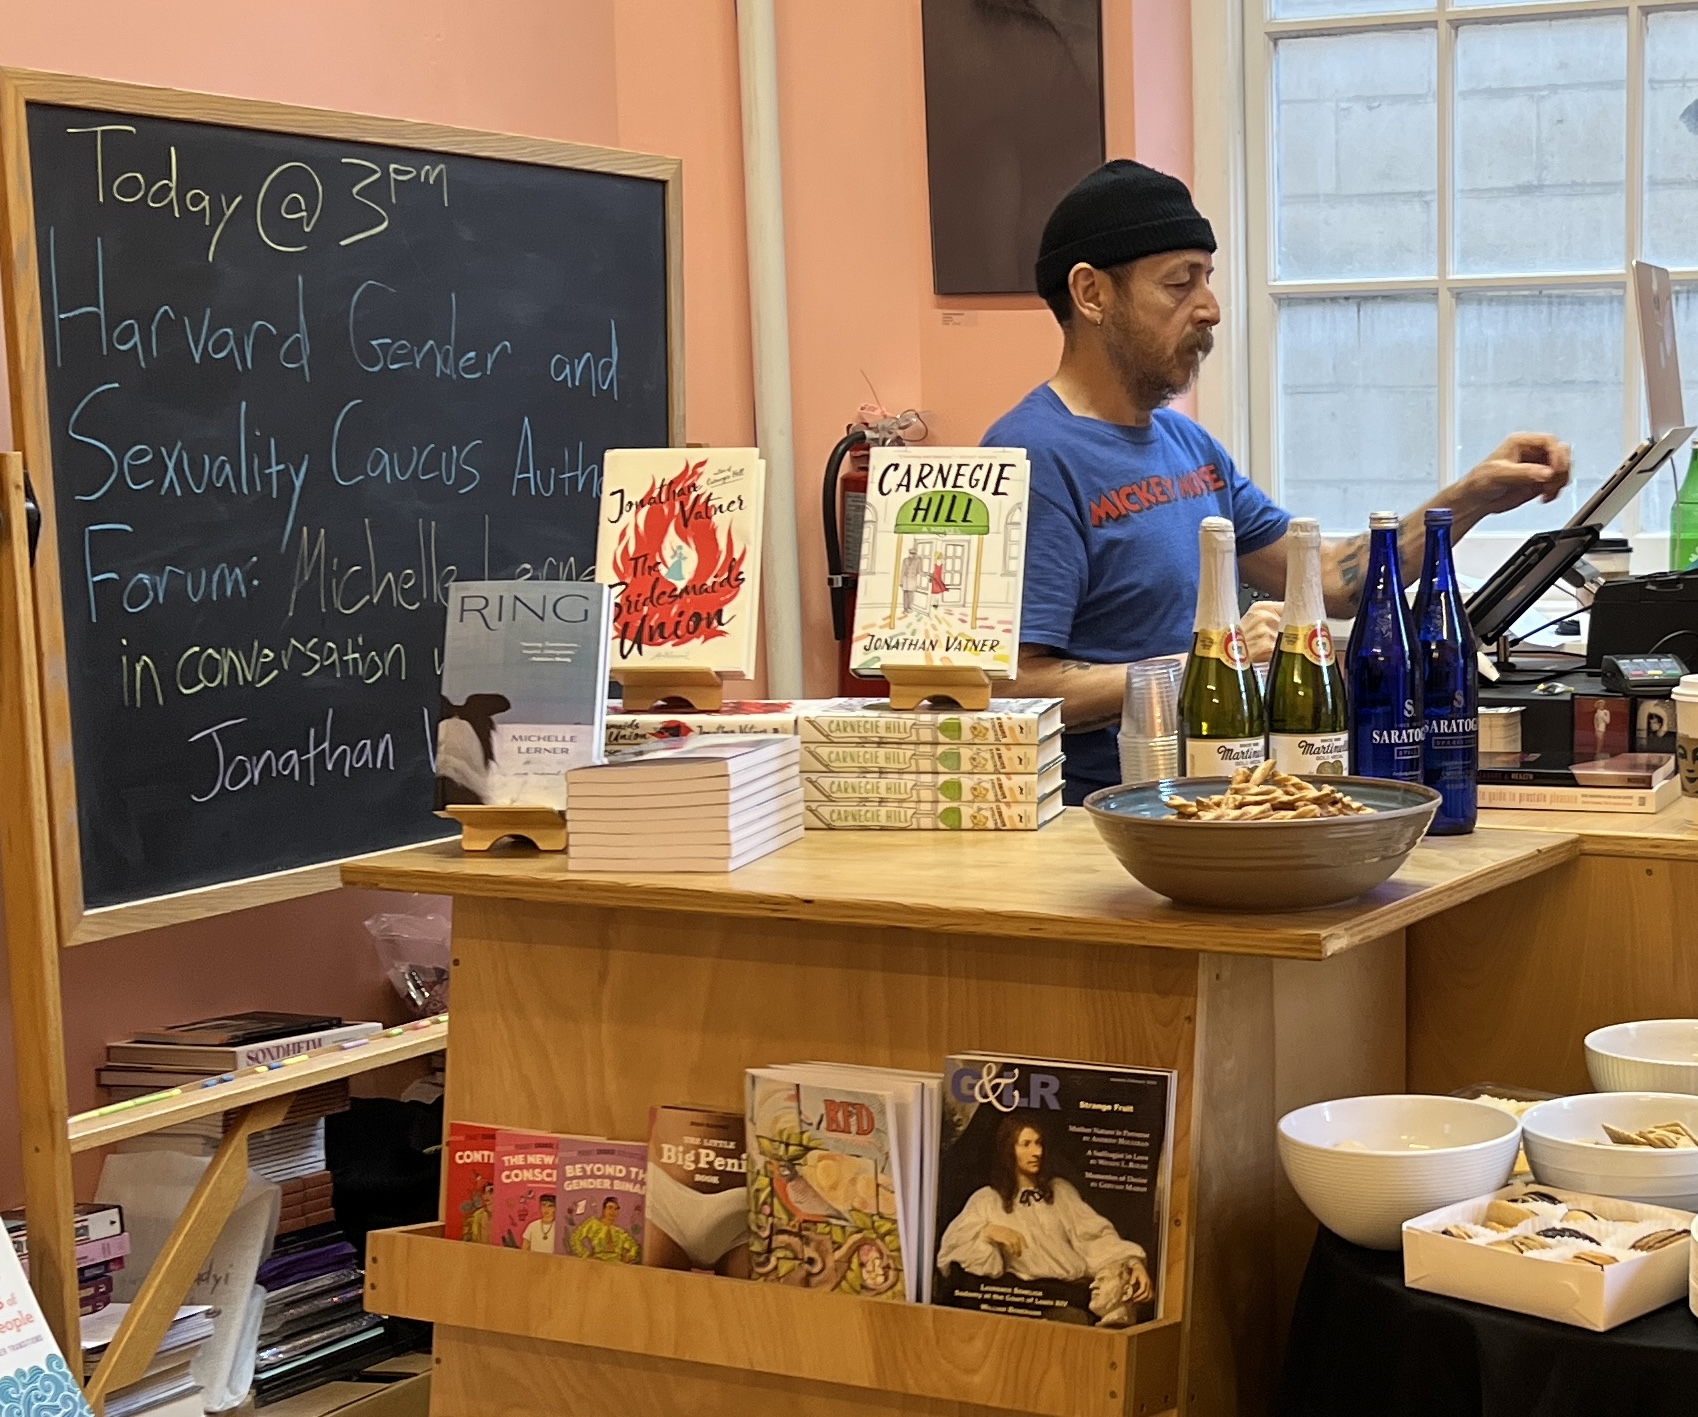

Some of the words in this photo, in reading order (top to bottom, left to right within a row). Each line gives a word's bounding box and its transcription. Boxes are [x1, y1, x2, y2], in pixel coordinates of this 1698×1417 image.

[66, 126, 242, 262] Today
[256, 162, 322, 252] @
[50, 226, 310, 383] Harvard
[350, 280, 512, 381] Gender
[550, 319, 619, 400] and
[68, 383, 310, 552] Sexuality
[331, 400, 483, 493] Caucus
[878, 463, 1017, 496] CARNEGIE
[607, 478, 702, 524] Jonathan
[679, 491, 748, 529] Vatner
[911, 493, 974, 523] HILL
[1089, 476, 1178, 528] MICKEY
[83, 522, 260, 622] Forum:
[288, 517, 458, 616] Michelle
[483, 514, 596, 582] Lerne
[628, 552, 663, 579] The
[459, 594, 591, 631] RING
[619, 606, 737, 660] Union
[863, 634, 938, 652] JONATHAN
[944, 636, 1001, 653] VATNER
[121, 639, 163, 706] in
[175, 634, 407, 695] conversation
[1403, 699, 1415, 718] S
[511, 734, 577, 743] MICHELLE
[827, 719, 880, 734] CARNEGIE
[884, 719, 909, 734] HILL
[188, 708, 395, 802] Jonathan
[517, 746, 570, 755] LERNER
[827, 749, 880, 764] CARNEGIE
[884, 749, 909, 764] HILL
[829, 780, 881, 795] CARNEGIE
[886, 780, 909, 795] HILL
[829, 809, 881, 824] CARNEGIE
[885, 809, 909, 824] HILL
[1079, 1101, 1112, 1112] Strange
[1113, 1103, 1134, 1112] Fruit
[660, 1143, 697, 1171] Big
[703, 1138, 737, 1149] LITTLE
[501, 1155, 526, 1166] THE
[527, 1154, 555, 1166] NEW
[565, 1163, 626, 1178] BEYOND
[630, 1167, 648, 1182] TH
[563, 1178, 612, 1191] GENDER
[694, 1173, 720, 1184] BOOK
